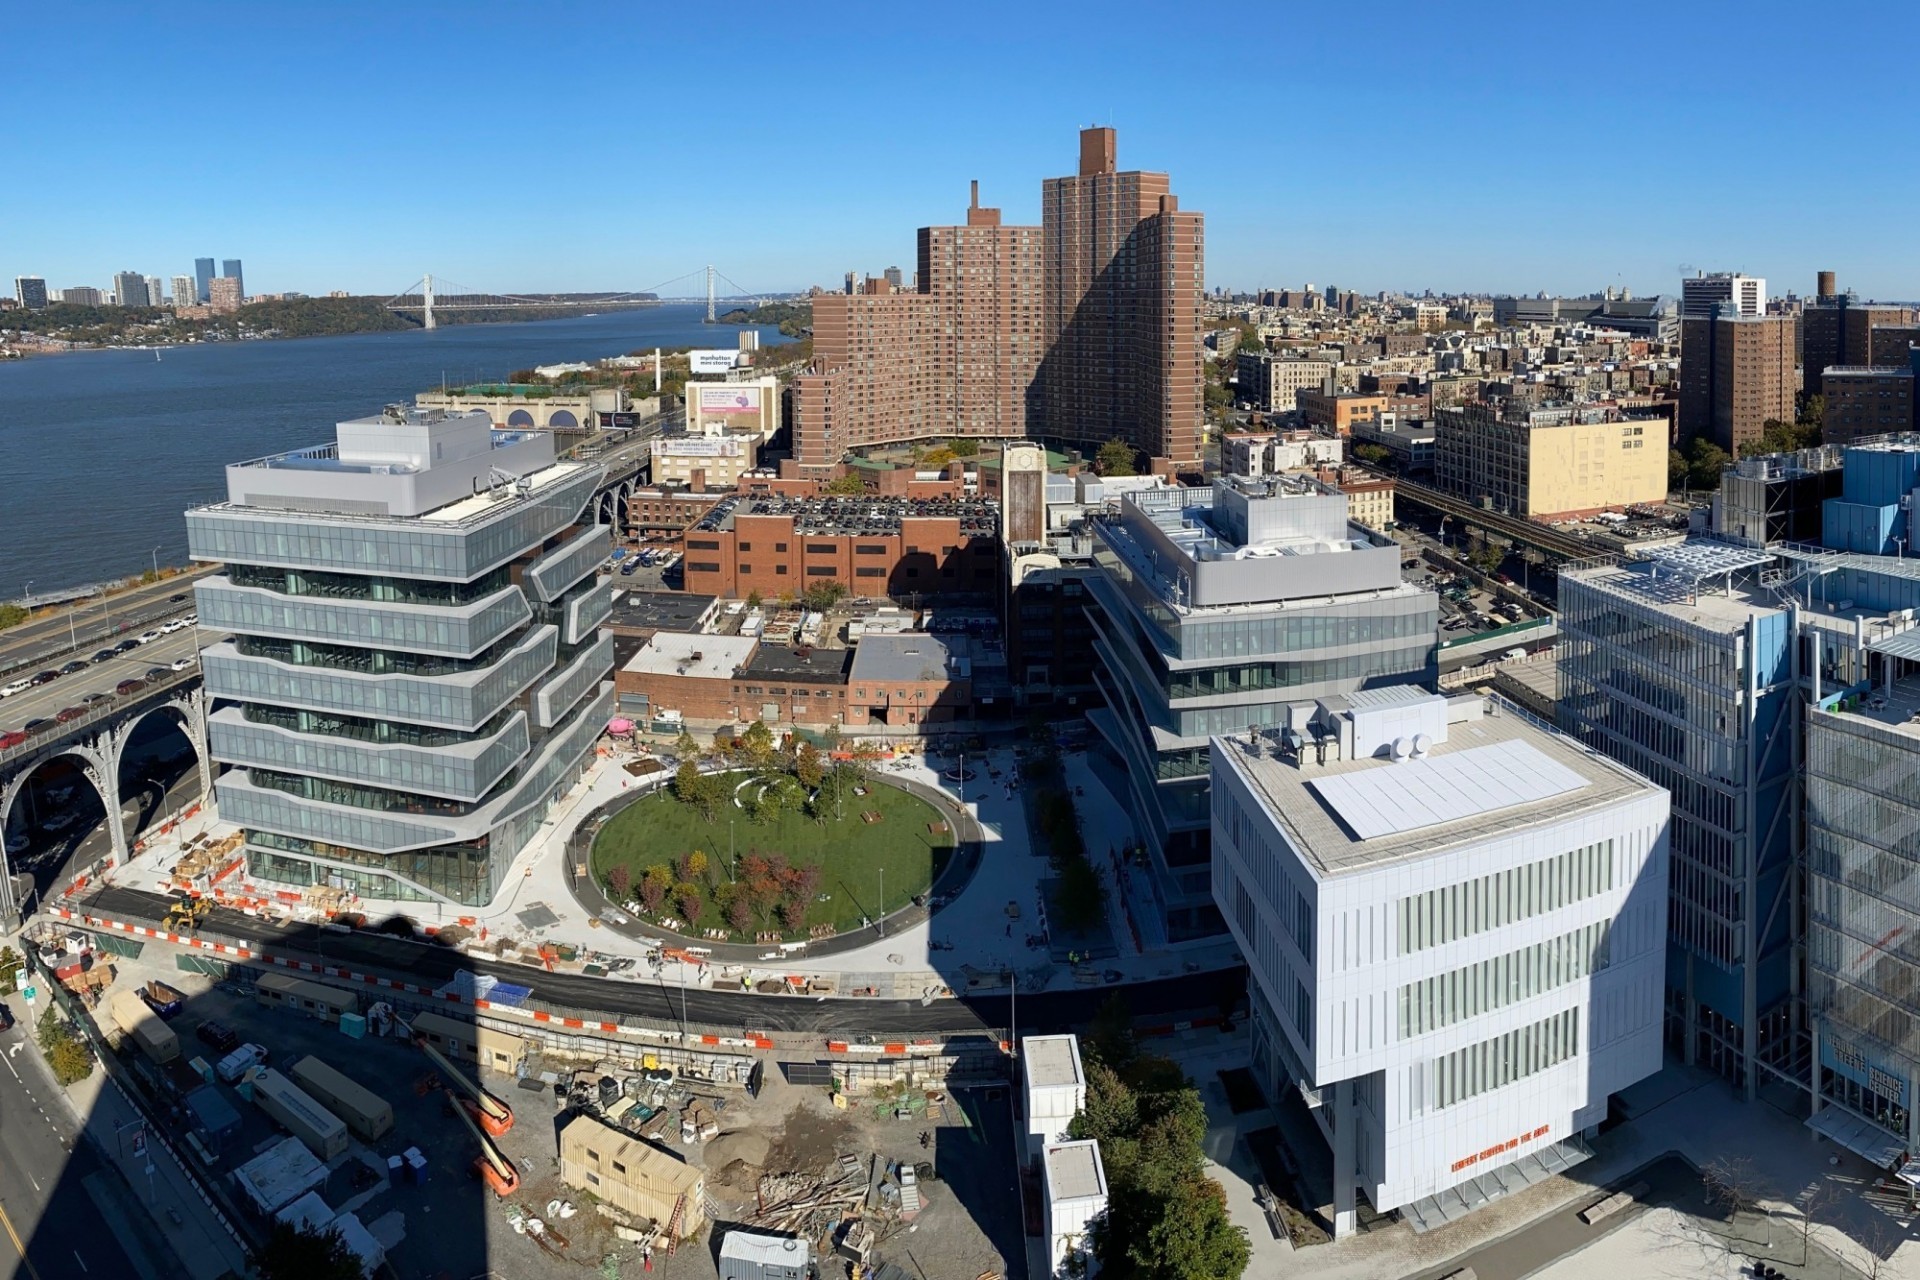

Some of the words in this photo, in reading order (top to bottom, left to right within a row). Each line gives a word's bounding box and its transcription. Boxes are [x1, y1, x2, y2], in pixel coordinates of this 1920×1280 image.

[1826, 1035, 1859, 1058] JEROME
[1834, 1049, 1865, 1073] GREENE
[1869, 1067, 1903, 1093] SCIENCE
[1869, 1079, 1899, 1103] CENTER
[1480, 1144, 1505, 1161] CENTER
[1506, 1138, 1518, 1151] FOR
[1520, 1132, 1531, 1143] THE
[1533, 1125, 1549, 1138] ARTS
